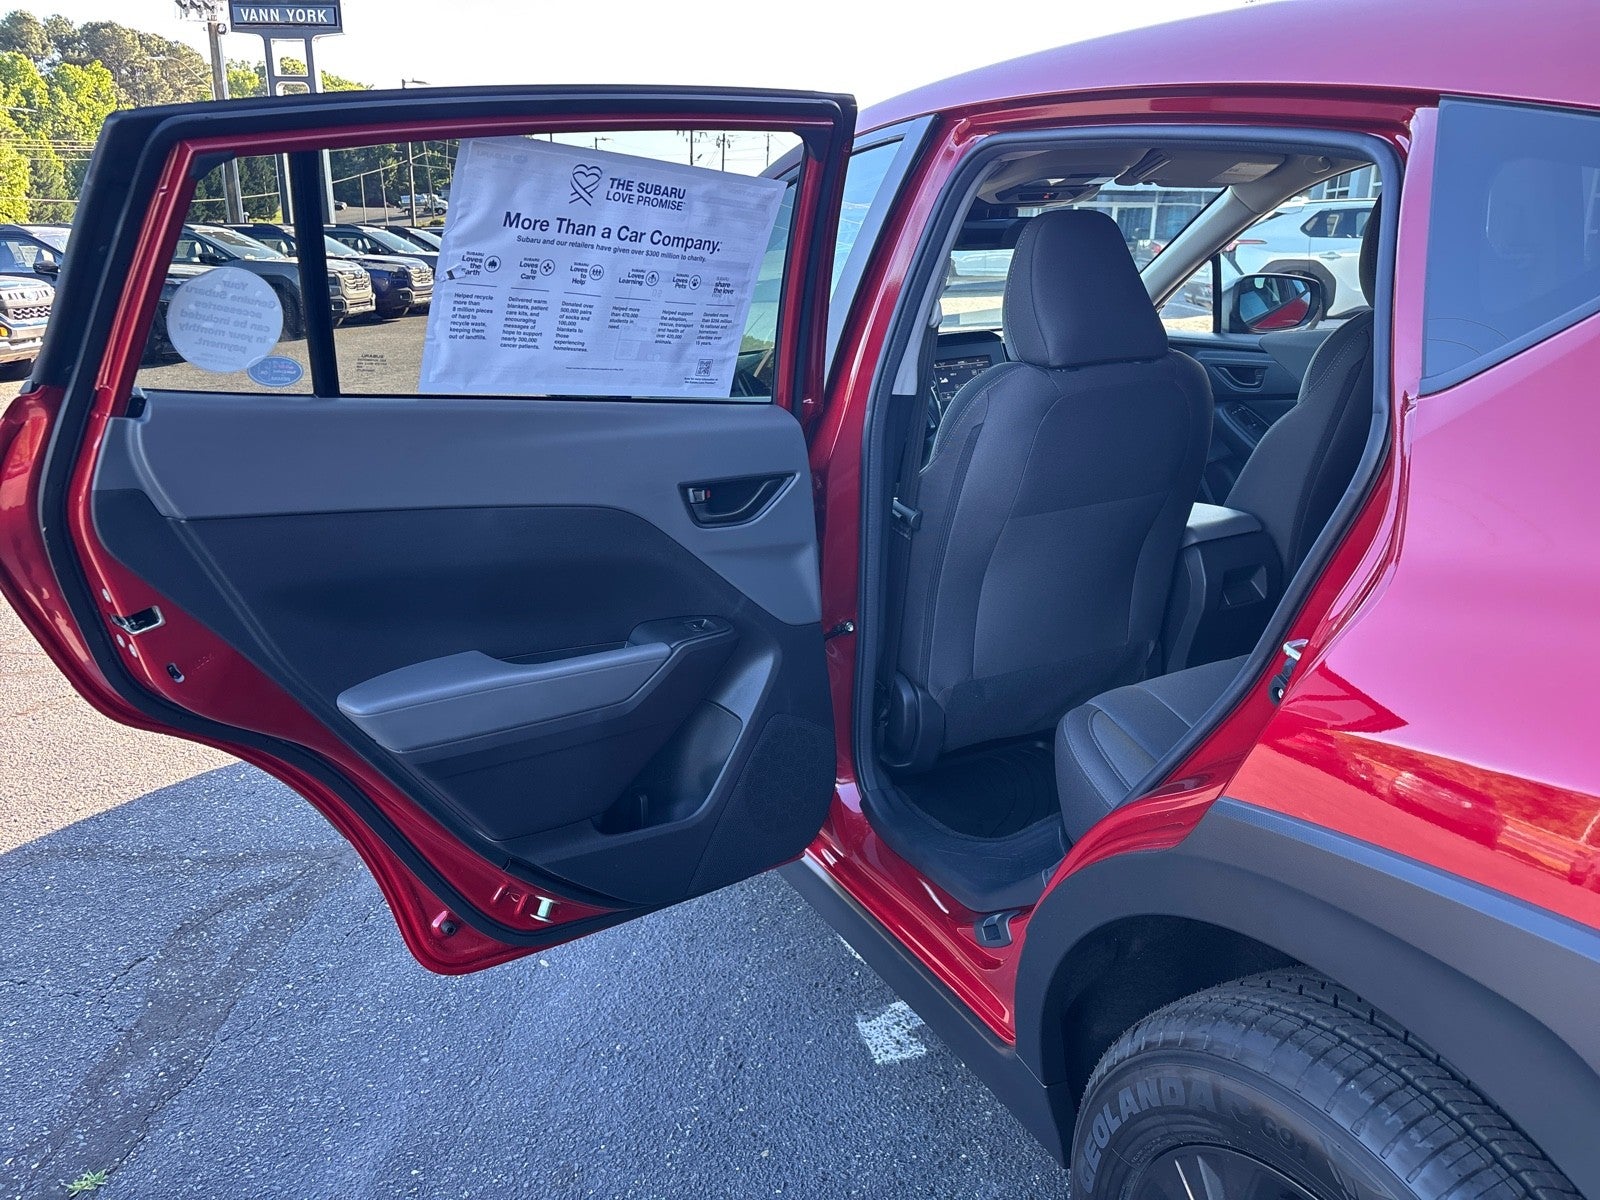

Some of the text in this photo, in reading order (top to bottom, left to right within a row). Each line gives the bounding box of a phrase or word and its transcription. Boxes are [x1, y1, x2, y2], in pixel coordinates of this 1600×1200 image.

[241, 9, 327, 22] VANN YORK
[609, 178, 686, 199] THE SUBARU
[606, 191, 686, 211] LOVE PROMISE
[503, 212, 550, 232] More
[556, 217, 596, 237] Than
[601, 228, 611, 239] a
[617, 226, 646, 243] Car
[462, 255, 483, 263] Loves
[517, 235, 541, 244] Subaru
[568, 241, 594, 250] retailers
[596, 244, 611, 252] have
[613, 246, 630, 254] given
[646, 248, 659, 258] $300
[661, 252, 680, 260] million
[687, 254, 707, 263] charity.
[619, 278, 643, 286] Learning
